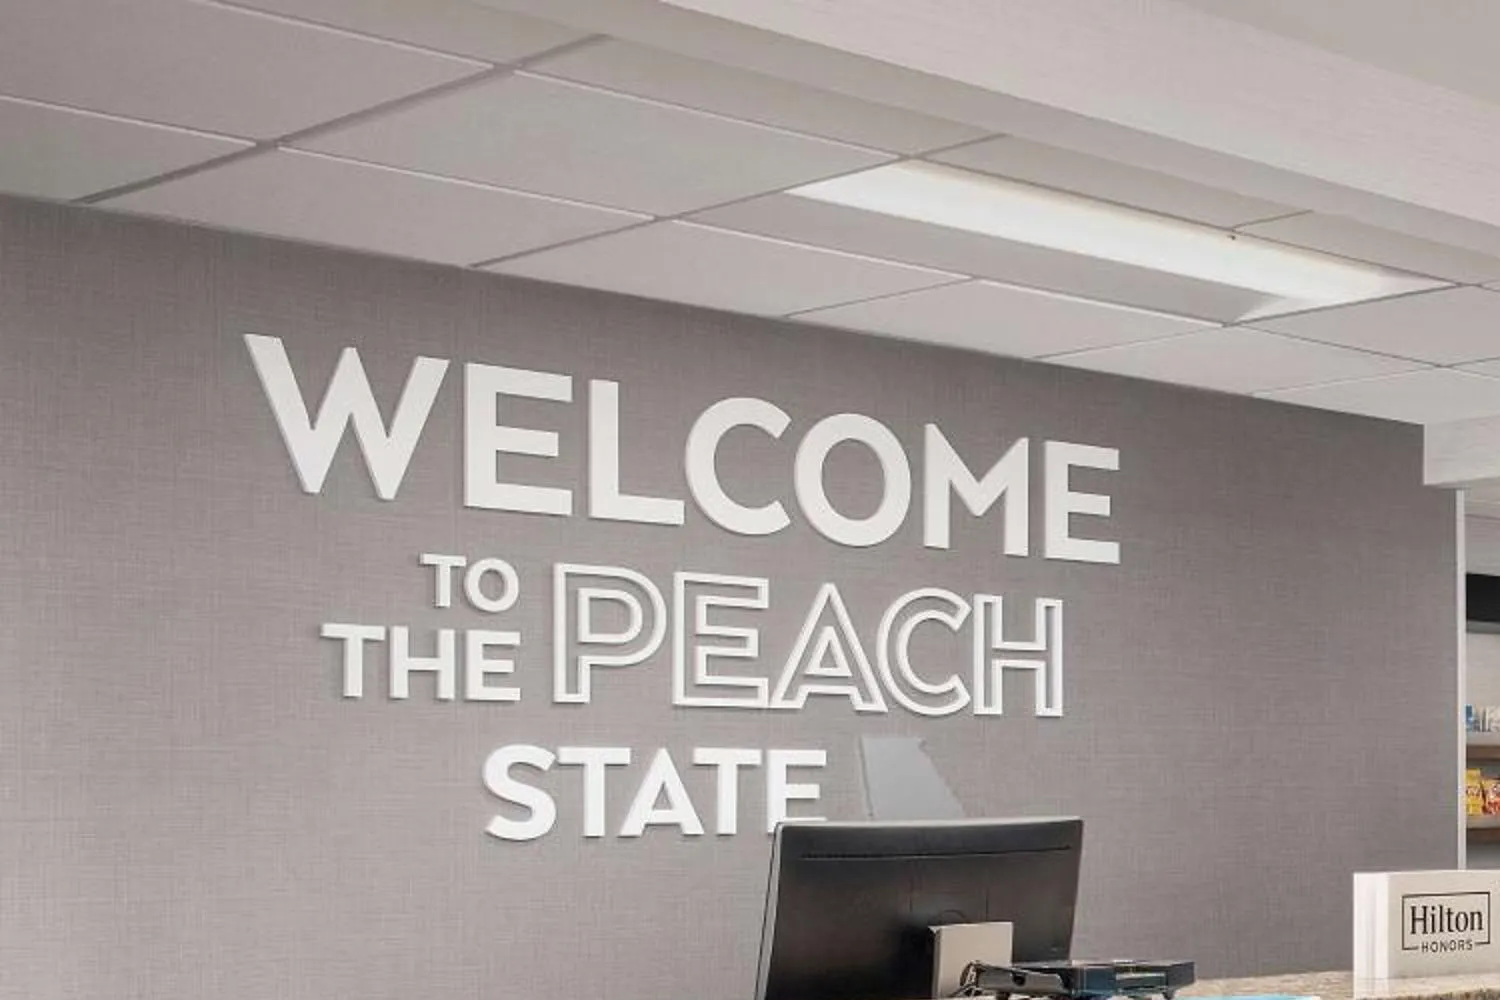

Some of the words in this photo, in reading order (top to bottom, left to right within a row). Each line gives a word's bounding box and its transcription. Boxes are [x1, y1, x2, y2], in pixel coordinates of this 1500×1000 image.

[243, 333, 1122, 564] WELCOME
[419, 552, 520, 613] TO
[319, 623, 521, 702] THE
[552, 562, 1064, 718] PEACH
[482, 744, 828, 841] STATE
[1410, 904, 1484, 935] Hilton
[1421, 939, 1473, 953] HONORS
